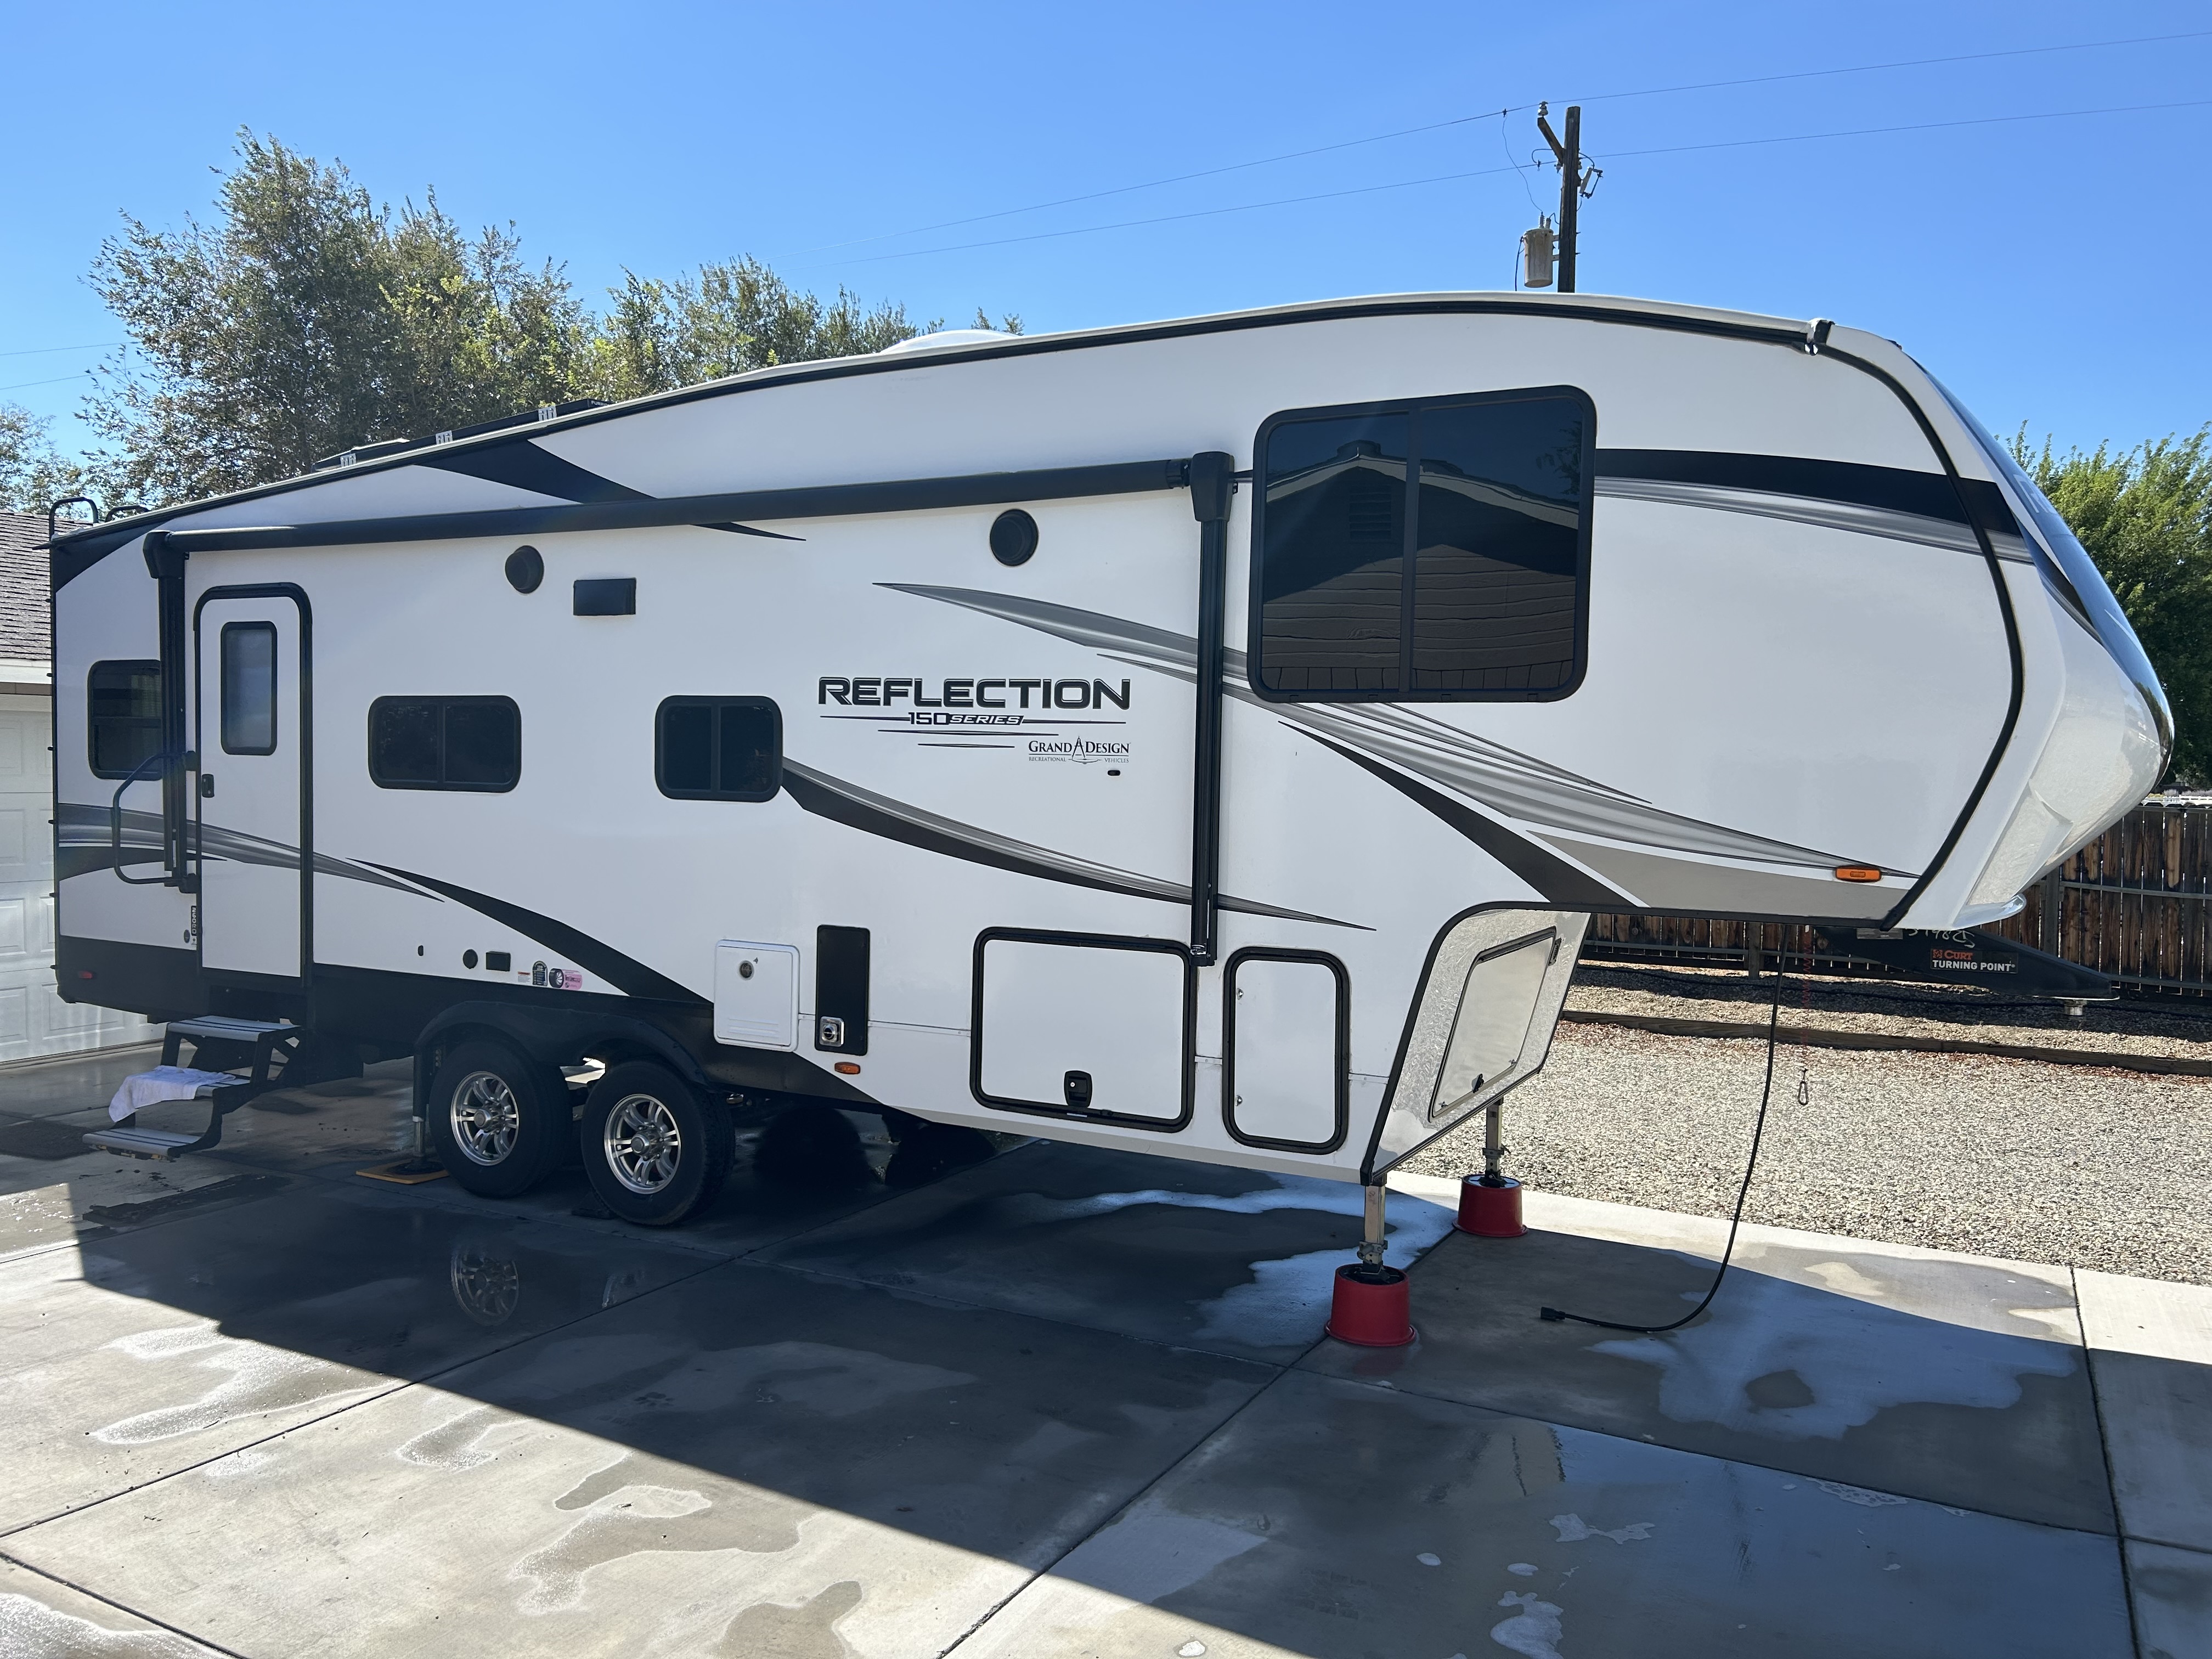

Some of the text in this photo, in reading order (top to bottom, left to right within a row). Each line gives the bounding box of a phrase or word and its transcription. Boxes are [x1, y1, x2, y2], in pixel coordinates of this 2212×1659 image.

[818, 676, 1131, 710] REFLECTION
[908, 712, 1020, 725] 150 SERIES
[1029, 741, 1129, 753] GRAND DESIGN
[1944, 950, 1973, 960] CURT
[1932, 960, 2012, 972] TURNING POINT
